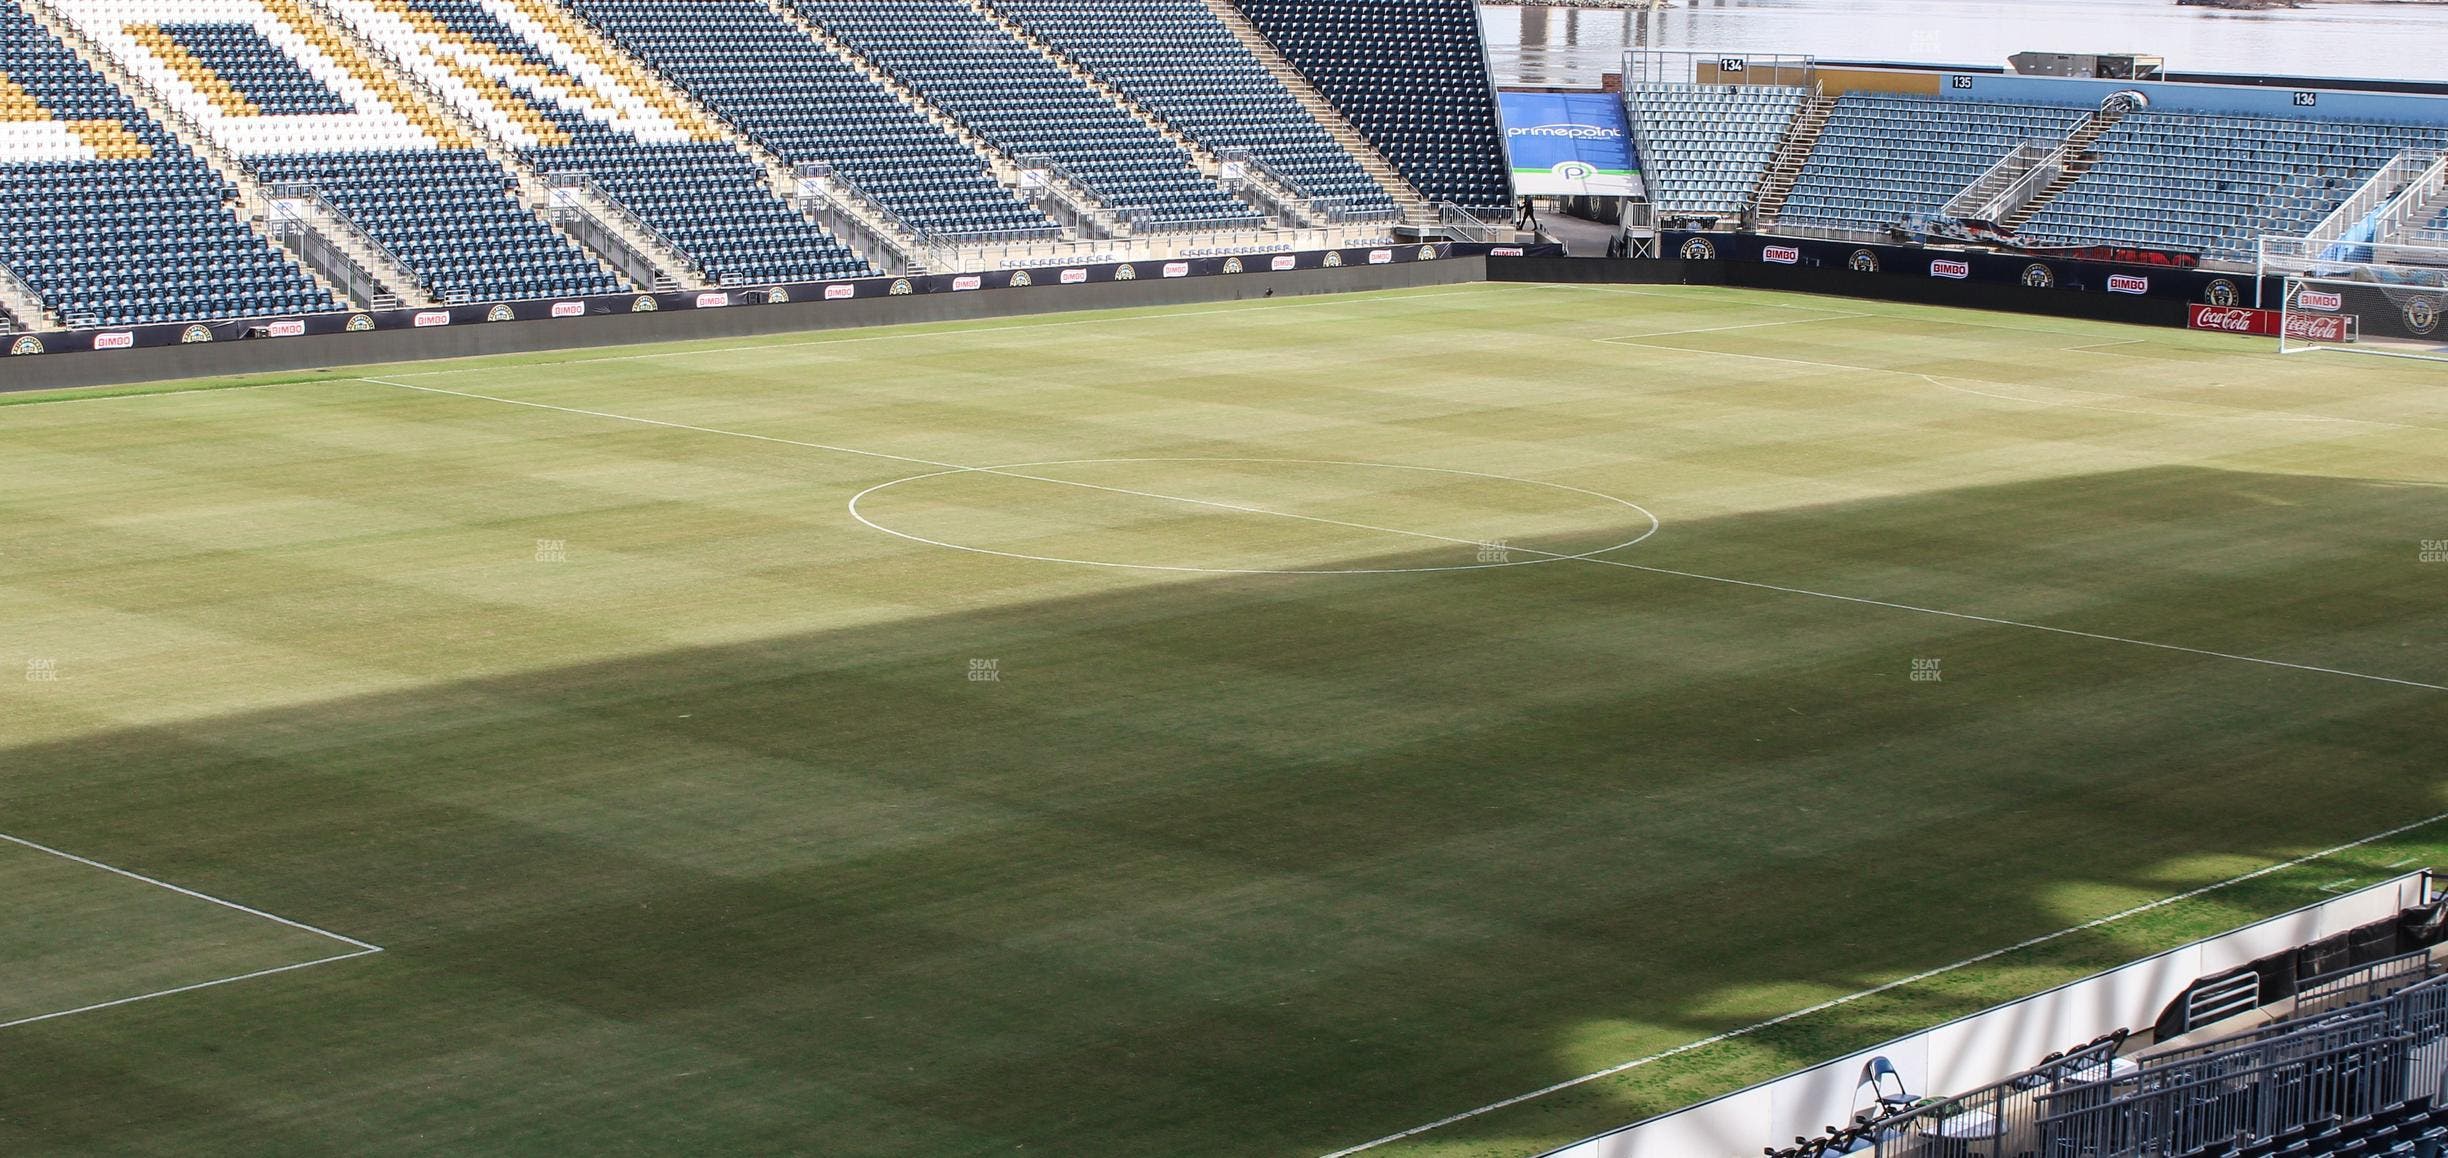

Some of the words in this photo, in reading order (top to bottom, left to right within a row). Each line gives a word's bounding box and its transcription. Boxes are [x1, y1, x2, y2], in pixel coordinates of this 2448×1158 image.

[1722, 59, 1742, 71] 134
[1954, 76, 1971, 88] 135
[2294, 93, 2315, 106] 136
[1766, 249, 1796, 260] BIMBO
[1933, 263, 1966, 275] BIMBO
[955, 280, 979, 289] BIMBO
[2110, 278, 2145, 290] BIMBO
[828, 288, 852, 297] BIMBO
[700, 296, 727, 306] BIMBO
[2301, 295, 2338, 307] BIMBO
[555, 305, 582, 315] BIMBO
[418, 316, 448, 326] BIMBO
[273, 325, 302, 335] BIMBO
[98, 336, 130, 347] BIMBO
